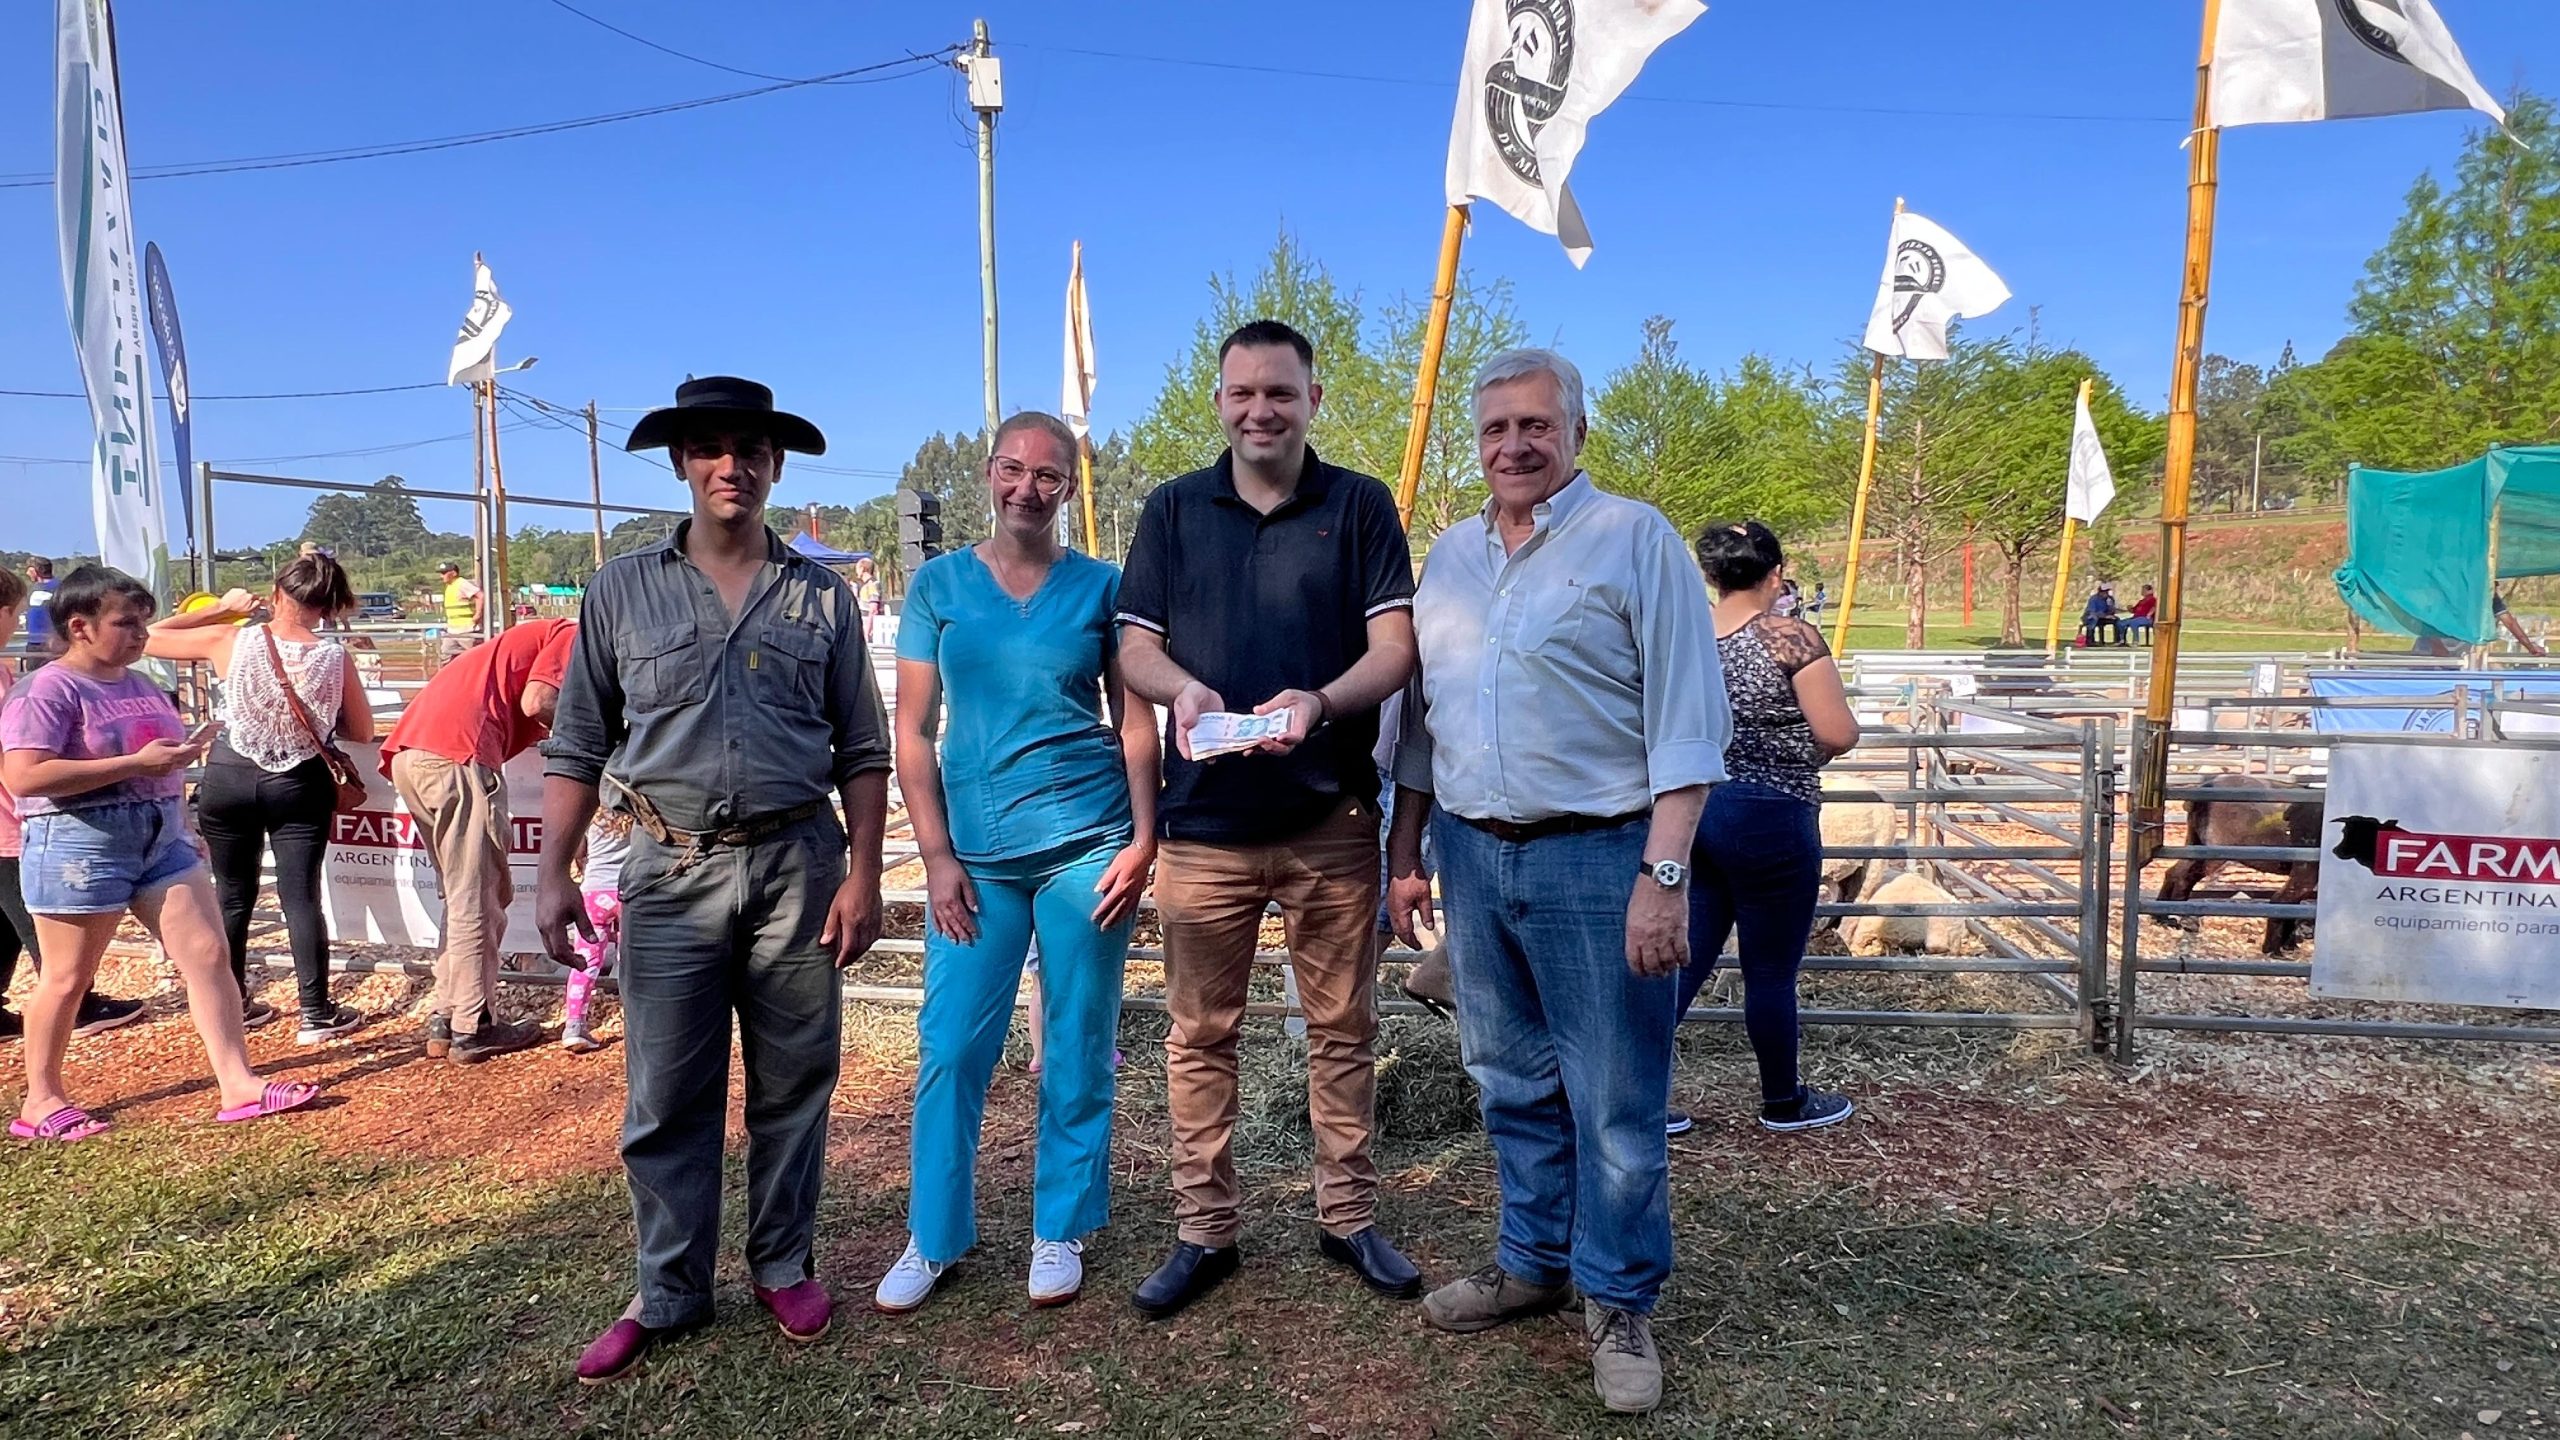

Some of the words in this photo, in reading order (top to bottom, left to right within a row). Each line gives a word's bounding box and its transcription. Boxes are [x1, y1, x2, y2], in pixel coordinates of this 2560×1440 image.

[333, 851, 433, 868] ARGENTIN
[2376, 886, 2557, 908] ARGENTINA
[2374, 915, 2509, 934] equipamiento
[2516, 922, 2560, 936] para
